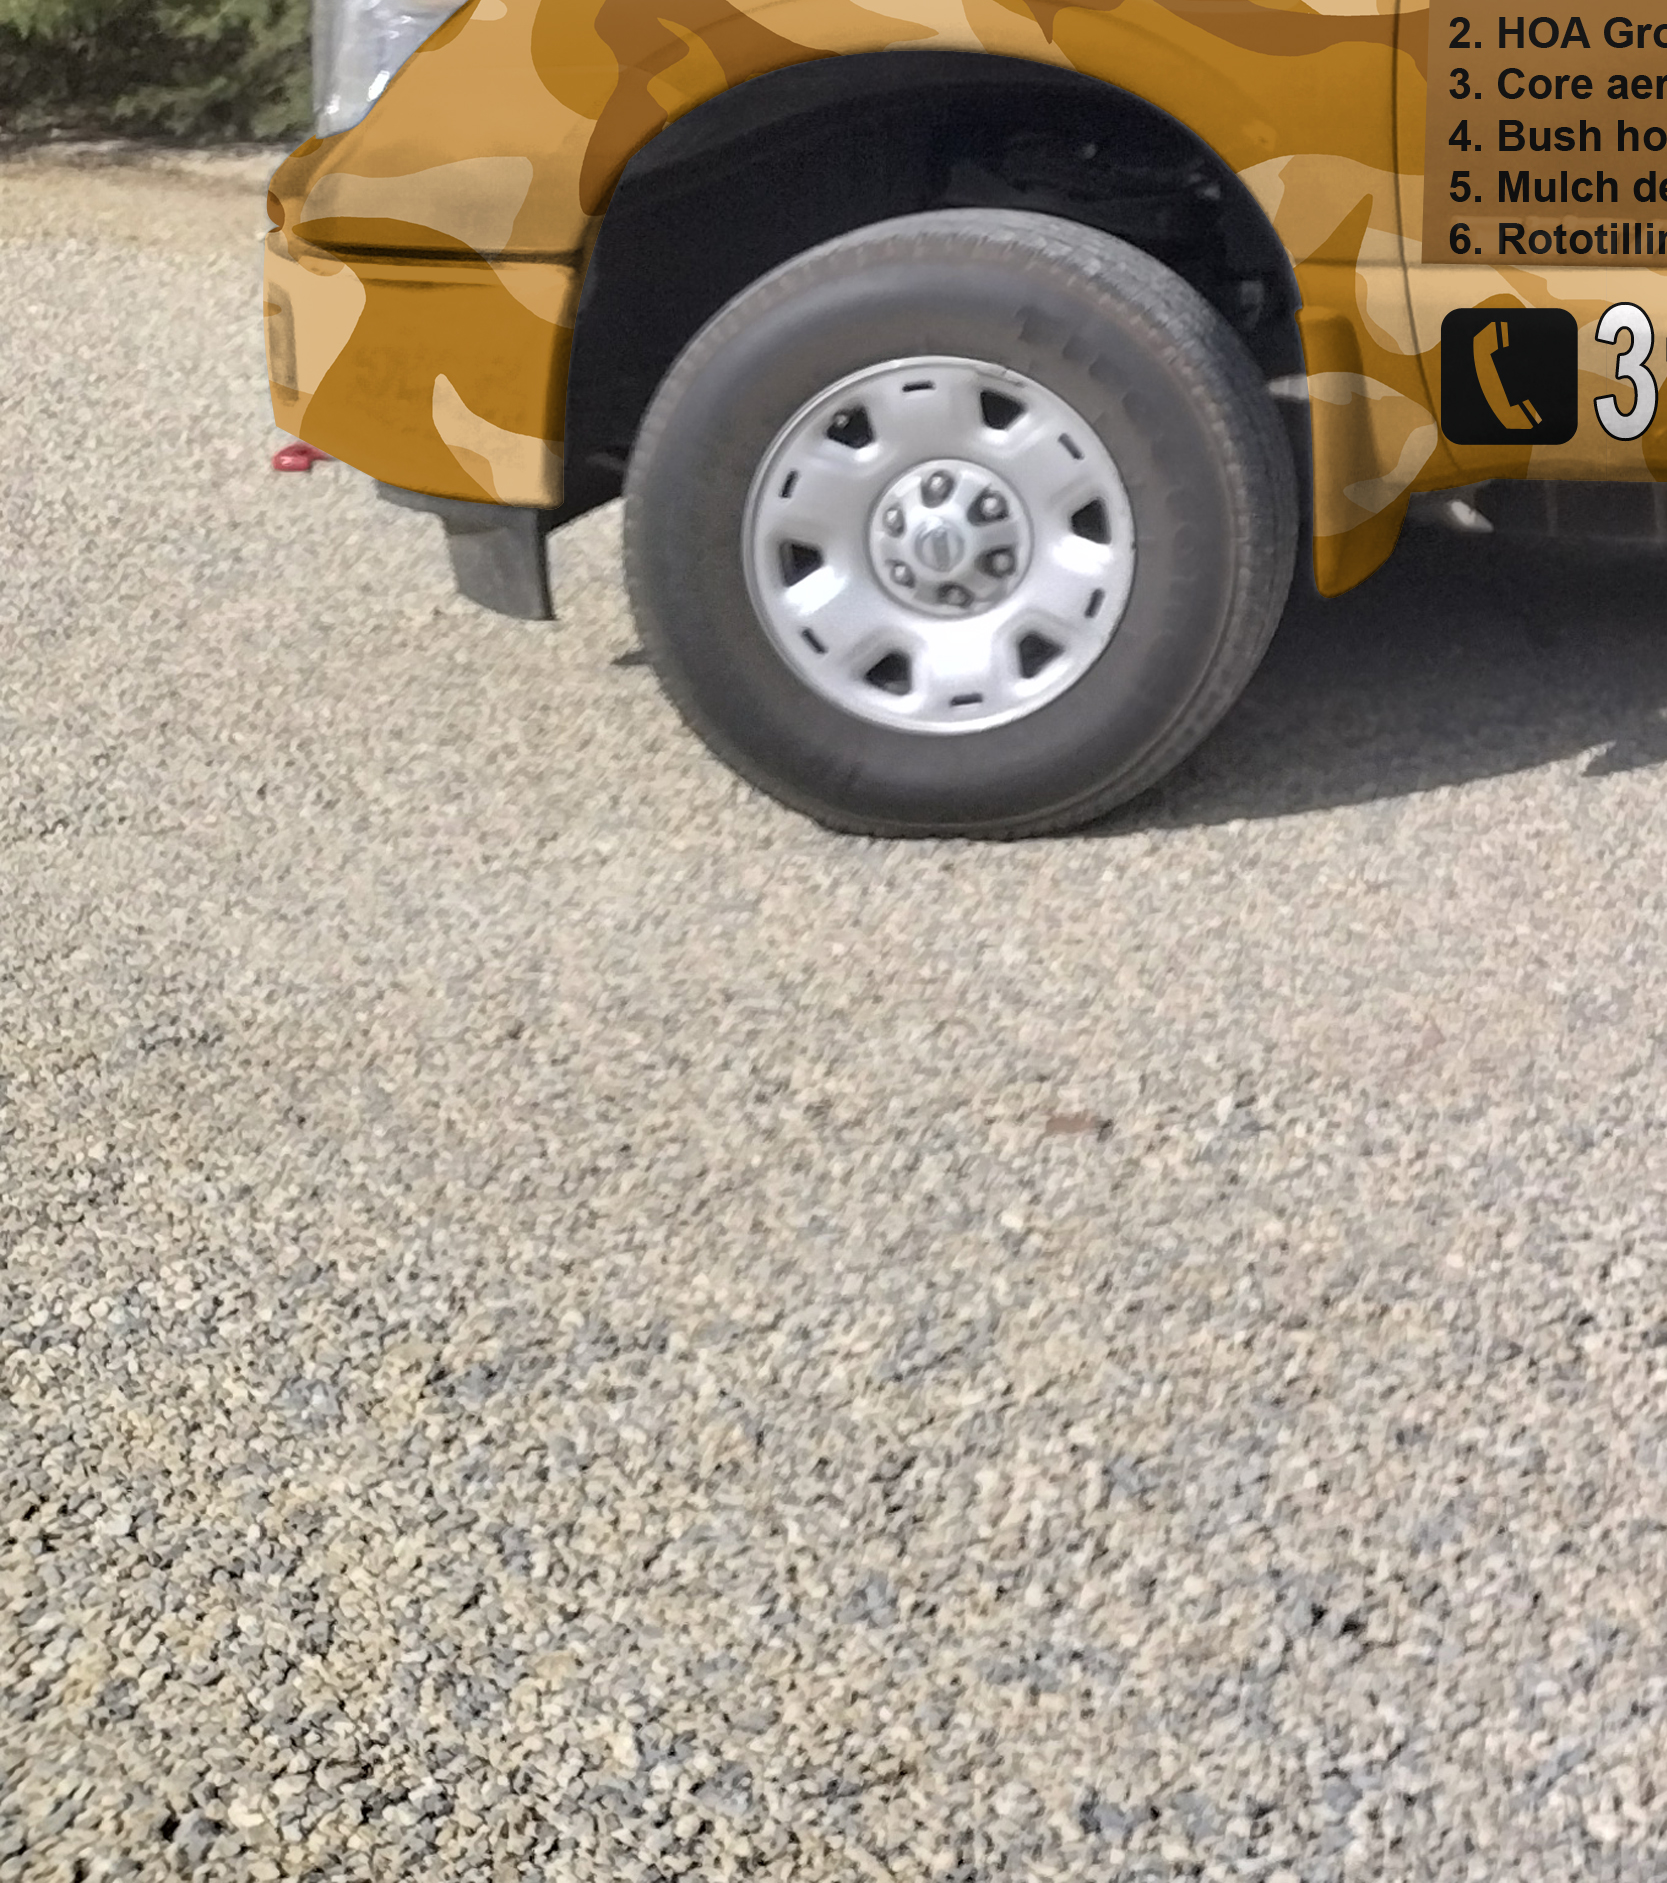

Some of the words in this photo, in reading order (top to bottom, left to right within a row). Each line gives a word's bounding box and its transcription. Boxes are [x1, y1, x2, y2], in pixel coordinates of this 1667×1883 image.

[1449, 16, 1482, 49] 2.
[1498, 16, 1591, 49] HOA
[1449, 67, 1482, 100] 3.
[1497, 67, 1593, 100] Core
[1448, 119, 1482, 152] 4.
[1498, 119, 1602, 152] Bush
[1449, 171, 1482, 203] 5.
[1497, 170, 1619, 203] Mulch
[1449, 222, 1482, 255] 6.
